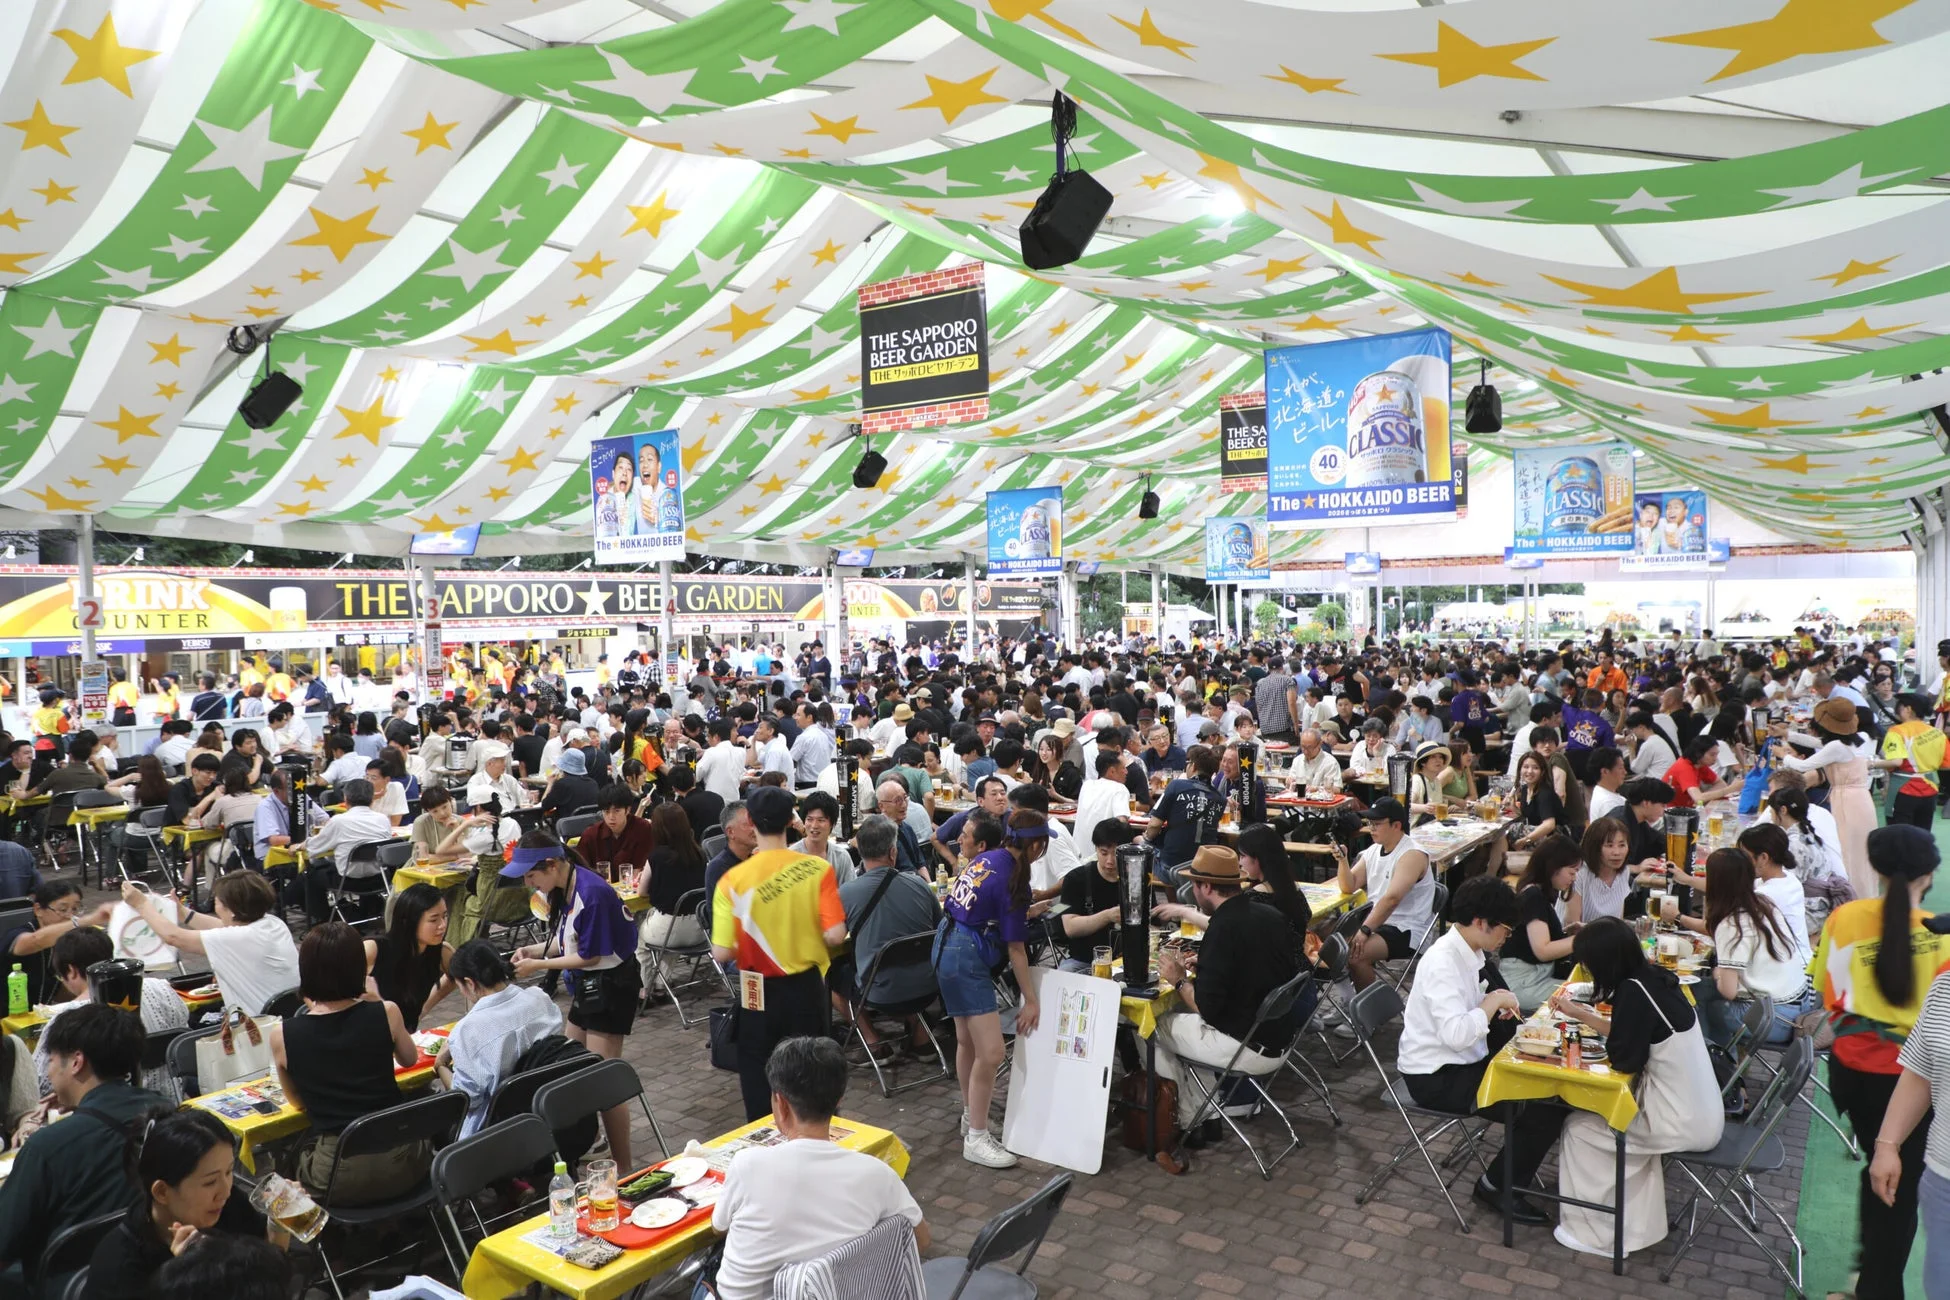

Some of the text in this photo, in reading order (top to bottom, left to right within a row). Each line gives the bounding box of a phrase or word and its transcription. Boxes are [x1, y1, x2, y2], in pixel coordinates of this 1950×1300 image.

[869, 318, 977, 351] THE SAPPORO
[870, 336, 977, 368] BEER GARDEN
[873, 370, 893, 382] THE
[1273, 385, 1345, 431] 北海道の
[1227, 426, 1249, 438] THE
[1349, 421, 1423, 459] CLASSIC
[1228, 437, 1255, 450] BEER
[1319, 454, 1338, 469] 40
[1271, 485, 1450, 511] The HOKKAIDO BEER
[1545, 490, 1606, 517] CLASSIC
[597, 535, 683, 550] The HOKKAIDO BEER
[1516, 535, 1632, 548] The HOKKAIDO BEER
[989, 559, 1060, 569] The HOKKAIDO BEER
[1644, 556, 1684, 564] HOKKAIDO
[336, 583, 409, 616] THE
[686, 585, 783, 612] GARDEN
[427, 598, 439, 619] 3
[666, 599, 676, 617] 4
[840, 598, 848, 613] 5
[83, 601, 99, 625] 2
[850, 605, 881, 616] UNTER
[181, 639, 211, 648] YEBISU
[1242, 772, 1250, 805] SAPPORO
[297, 793, 305, 825] SAPPORO
